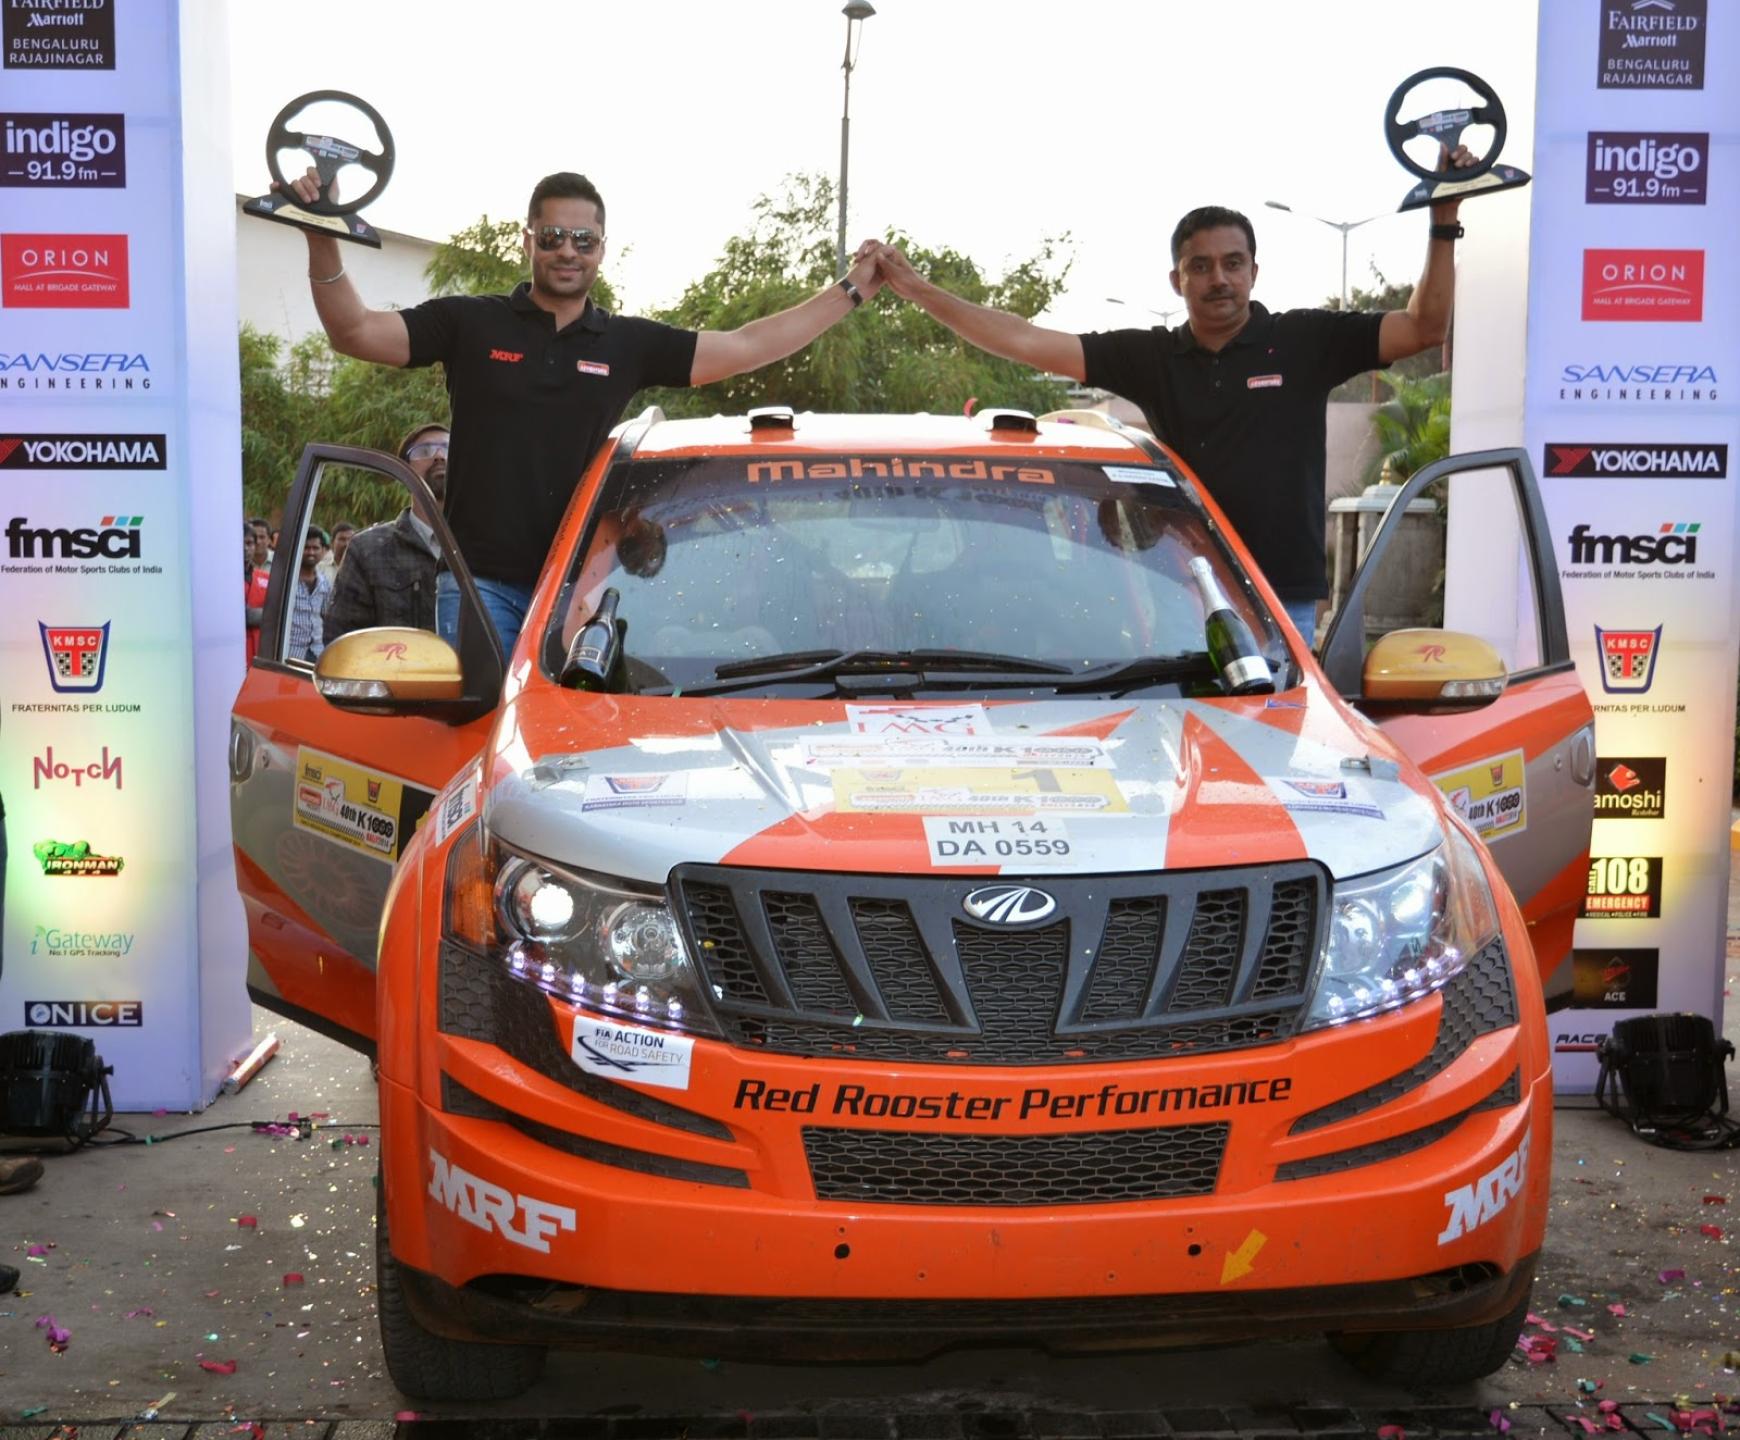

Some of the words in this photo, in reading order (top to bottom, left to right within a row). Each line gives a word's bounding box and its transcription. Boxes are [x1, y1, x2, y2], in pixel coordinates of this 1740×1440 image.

[26, 12, 84, 27] Marriott
[1608, 10, 1698, 32] FAIRFIELD
[13, 38, 99, 50] BENGALURU
[1622, 34, 1677, 48] Marriott
[9, 53, 104, 64] RAJAJINAGAR
[1607, 59, 1690, 70] BENGALURU
[1603, 73, 1693, 84] RAJAJINAGAR
[6, 120, 117, 161] indigo
[1594, 139, 1700, 179] indigo
[27, 161, 76, 180] 91.9
[78, 167, 98, 180] fm
[1613, 178, 1660, 197] 91.9
[1662, 184, 1680, 197] fm
[21, 249, 109, 266] ORION
[1602, 264, 1686, 281] ORION
[14, 283, 33, 292] MALL
[36, 283, 45, 292] AT
[47, 283, 79, 292] BRIGADE
[81, 283, 117, 292] GATEWAY
[1593, 297, 1611, 305] MALL
[1614, 297, 1623, 305] AT
[1625, 297, 1655, 305] BRIGADE
[1657, 297, 1691, 305] GATEWAY
[1561, 364, 1718, 384] SANSERA
[1560, 388, 1718, 400] ENGINEERING
[23, 441, 160, 463] YOKOHAMA
[1591, 450, 1720, 472] YOKOHAMA
[5, 516, 142, 559] fmsci
[1568, 524, 1697, 564] fmsci
[1, 565, 43, 573] Federation
[45, 565, 53, 573] of
[55, 565, 78, 573] Motor
[80, 565, 106, 575] Sports
[108, 565, 131, 573] Clubs
[133, 565, 141, 573] of
[142, 565, 163, 573] India
[1562, 571, 1601, 579] Federation
[1604, 571, 1612, 579] of
[1614, 571, 1635, 579] Motor
[1637, 571, 1662, 580] Sports
[1664, 571, 1685, 579] Clubs
[1687, 571, 1695, 579] of
[1696, 571, 1715, 579] India
[53, 635, 97, 646] KMSC
[1606, 639, 1648, 649] KMSC
[12, 704, 80, 713] FRATERNITAS
[83, 704, 103, 713] PER
[106, 704, 141, 713] LUDUM
[1630, 705, 1650, 713] PER
[1652, 705, 1686, 713] LUDUM
[950, 821, 999, 834] MH
[1012, 821, 1048, 834] 14
[937, 840, 987, 856] DA
[995, 840, 1070, 856] 0559
[46, 860, 119, 870] IRONMAN
[1592, 857, 1649, 895] 108
[1586, 896, 1650, 910] EMERGENCY
[69, 949, 86, 957] GPS
[88, 949, 121, 959] Tracking
[1603, 991, 1626, 1001] ACE
[614, 1030, 664, 1049] ACTION
[594, 1040, 609, 1048] FOR
[609, 1043, 640, 1057] ROAD
[641, 1049, 684, 1063] SAFETY
[734, 1079, 821, 1113] Red
[832, 1084, 1012, 1120] Rooster
[1019, 1077, 1292, 1120] Performance
[428, 1149, 577, 1254] MRF
